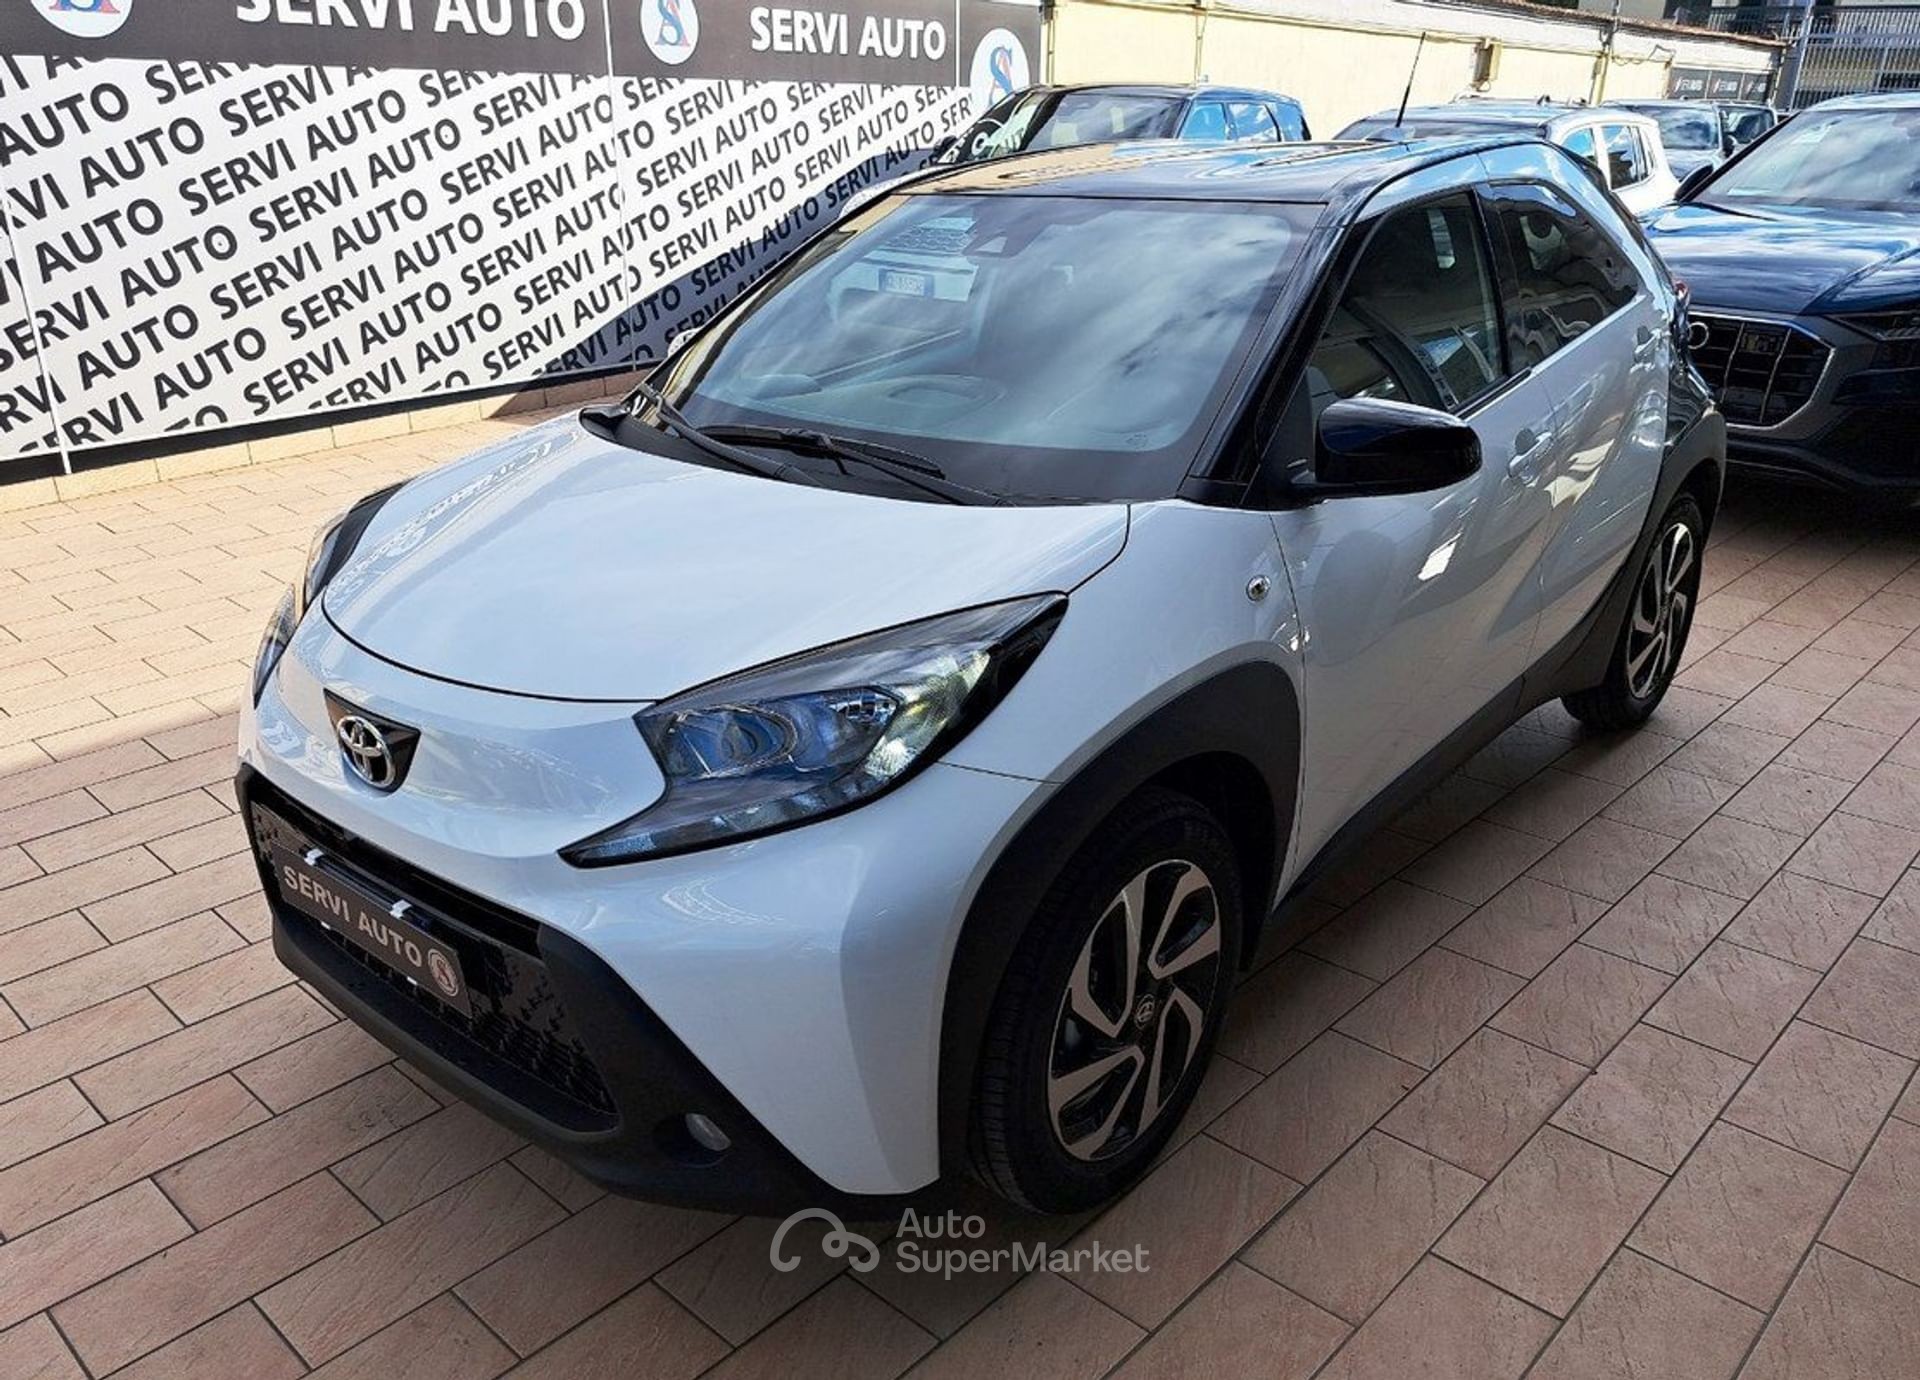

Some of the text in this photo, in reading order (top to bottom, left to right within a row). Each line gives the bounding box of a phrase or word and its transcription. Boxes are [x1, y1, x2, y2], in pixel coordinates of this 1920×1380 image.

[0, 83, 128, 167] AUTO
[80, 117, 204, 198] AUTO
[220, 64, 333, 137] SERVI
[434, 0, 587, 41] AUTO
[750, 7, 946, 61] SERVI AUTO
[36, 199, 163, 284] AUTO
[179, 138, 296, 216] SERVI
[307, 90, 405, 161] AUTO
[78, 304, 198, 391] AUTO
[210, 242, 322, 320] SERVI
[333, 189, 427, 261] AUTO
[441, 137, 529, 204] SERVI
[539, 95, 612, 157] AUTO
[121, 225, 237, 308] AUTO
[249, 167, 358, 242] SERVI
[368, 119, 460, 188] AUTO
[473, 71, 560, 135] SERVI
[154, 328, 266, 411] AUTO
[281, 265, 385, 340] SERVI
[395, 213, 483, 283] AUTO
[493, 163, 576, 228] SERVI
[586, 121, 654, 181] AUTO
[666, 80, 733, 135] SERVI
[244, 337, 350, 416] SERVI
[360, 282, 451, 355] AUTO
[461, 228, 547, 295] SERVI
[556, 183, 625, 245] AUTO
[637, 137, 707, 196] SERVI
[717, 98, 777, 153] AUTO
[416, 303, 501, 374] AUTO
[514, 249, 594, 314] SERVI
[603, 204, 669, 265] AUTO
[678, 160, 744, 218] SERVI
[752, 121, 809, 175] AUTO
[819, 82, 874, 133] SERVI
[483, 313, 565, 380] SERVI
[574, 266, 641, 328] AUTO
[649, 218, 718, 278] SERVI
[727, 177, 785, 233] AUTO
[795, 136, 850, 188] SERVI
[858, 101, 908, 150] AUTO
[616, 284, 681, 346] AUTO
[691, 237, 755, 295] SERVI
[762, 195, 819, 250] AUTO
[825, 157, 879, 208] SERVI
[885, 121, 934, 171] AUTO
[283, 866, 423, 967] SERVI AUTO
